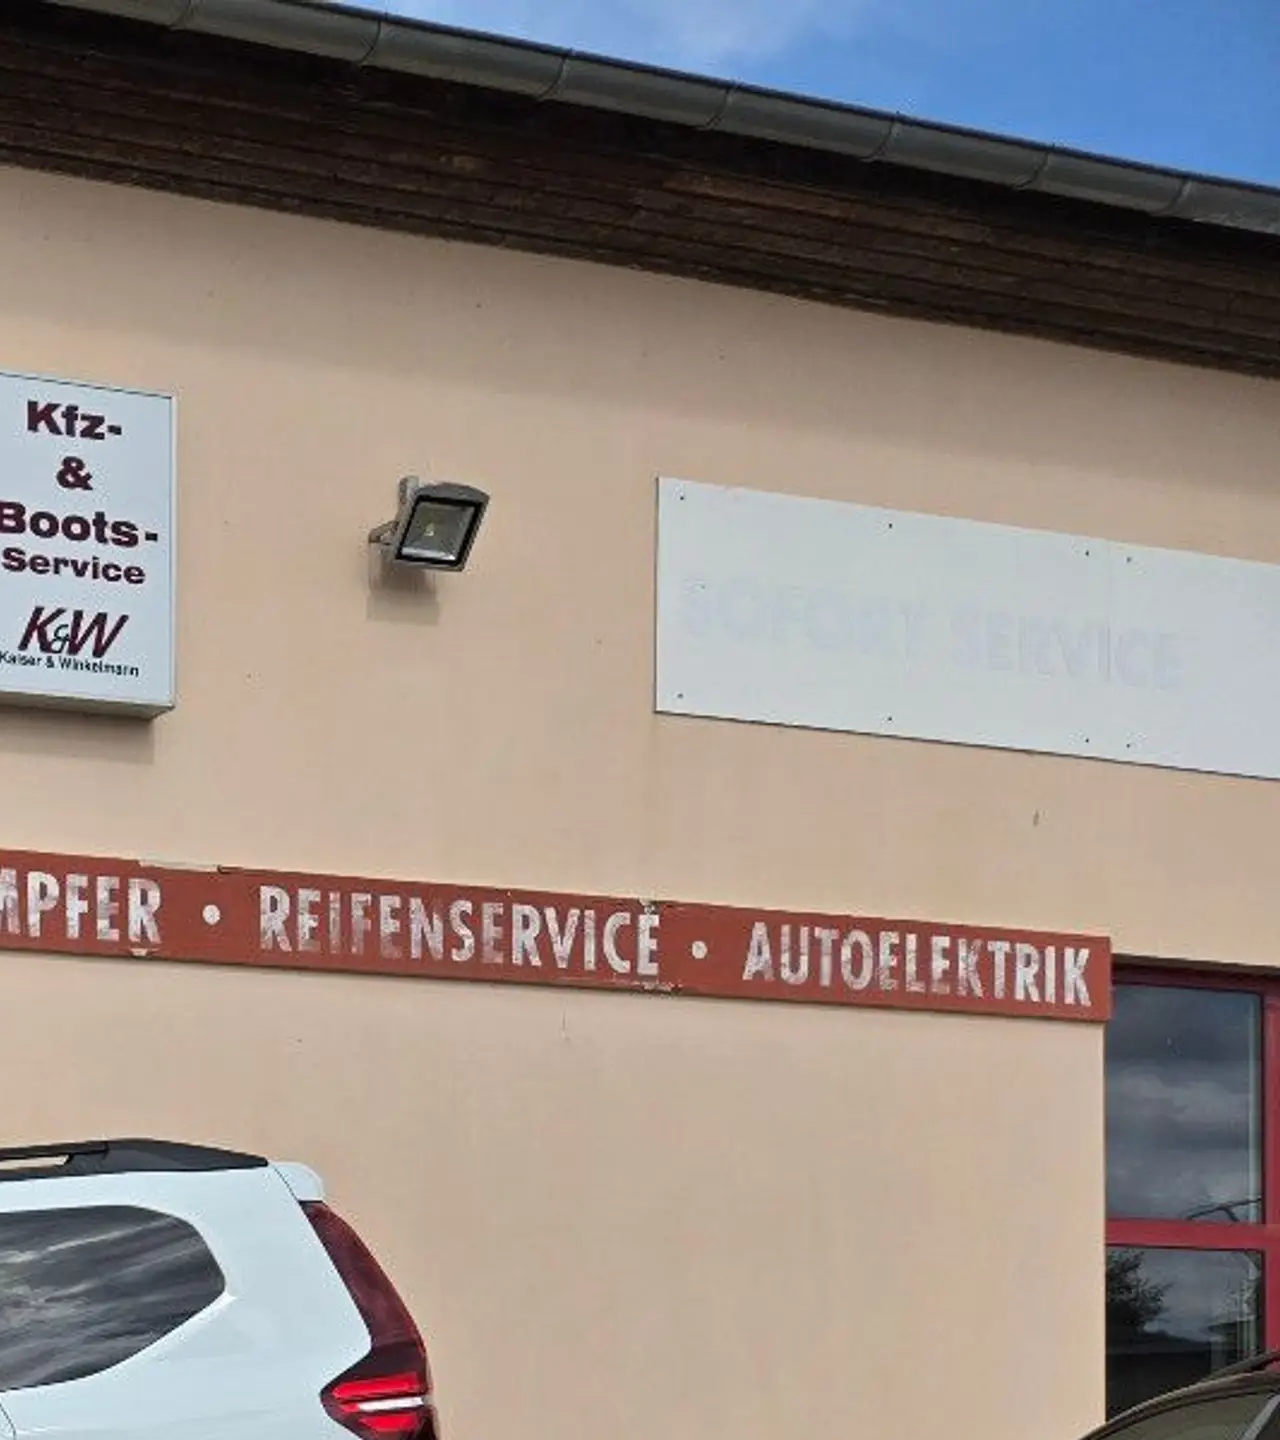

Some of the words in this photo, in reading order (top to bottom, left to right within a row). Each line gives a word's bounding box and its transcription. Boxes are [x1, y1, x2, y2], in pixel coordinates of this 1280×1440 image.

[27, 401, 122, 440] Kfz-
[56, 456, 94, 491] &
[1, 546, 146, 584] Service
[17, 606, 130, 659] K&W
[45, 655, 55, 669] &
[259, 884, 661, 976] REIFENSERVICE
[741, 920, 1093, 1008] AUTOELEKTRIK
